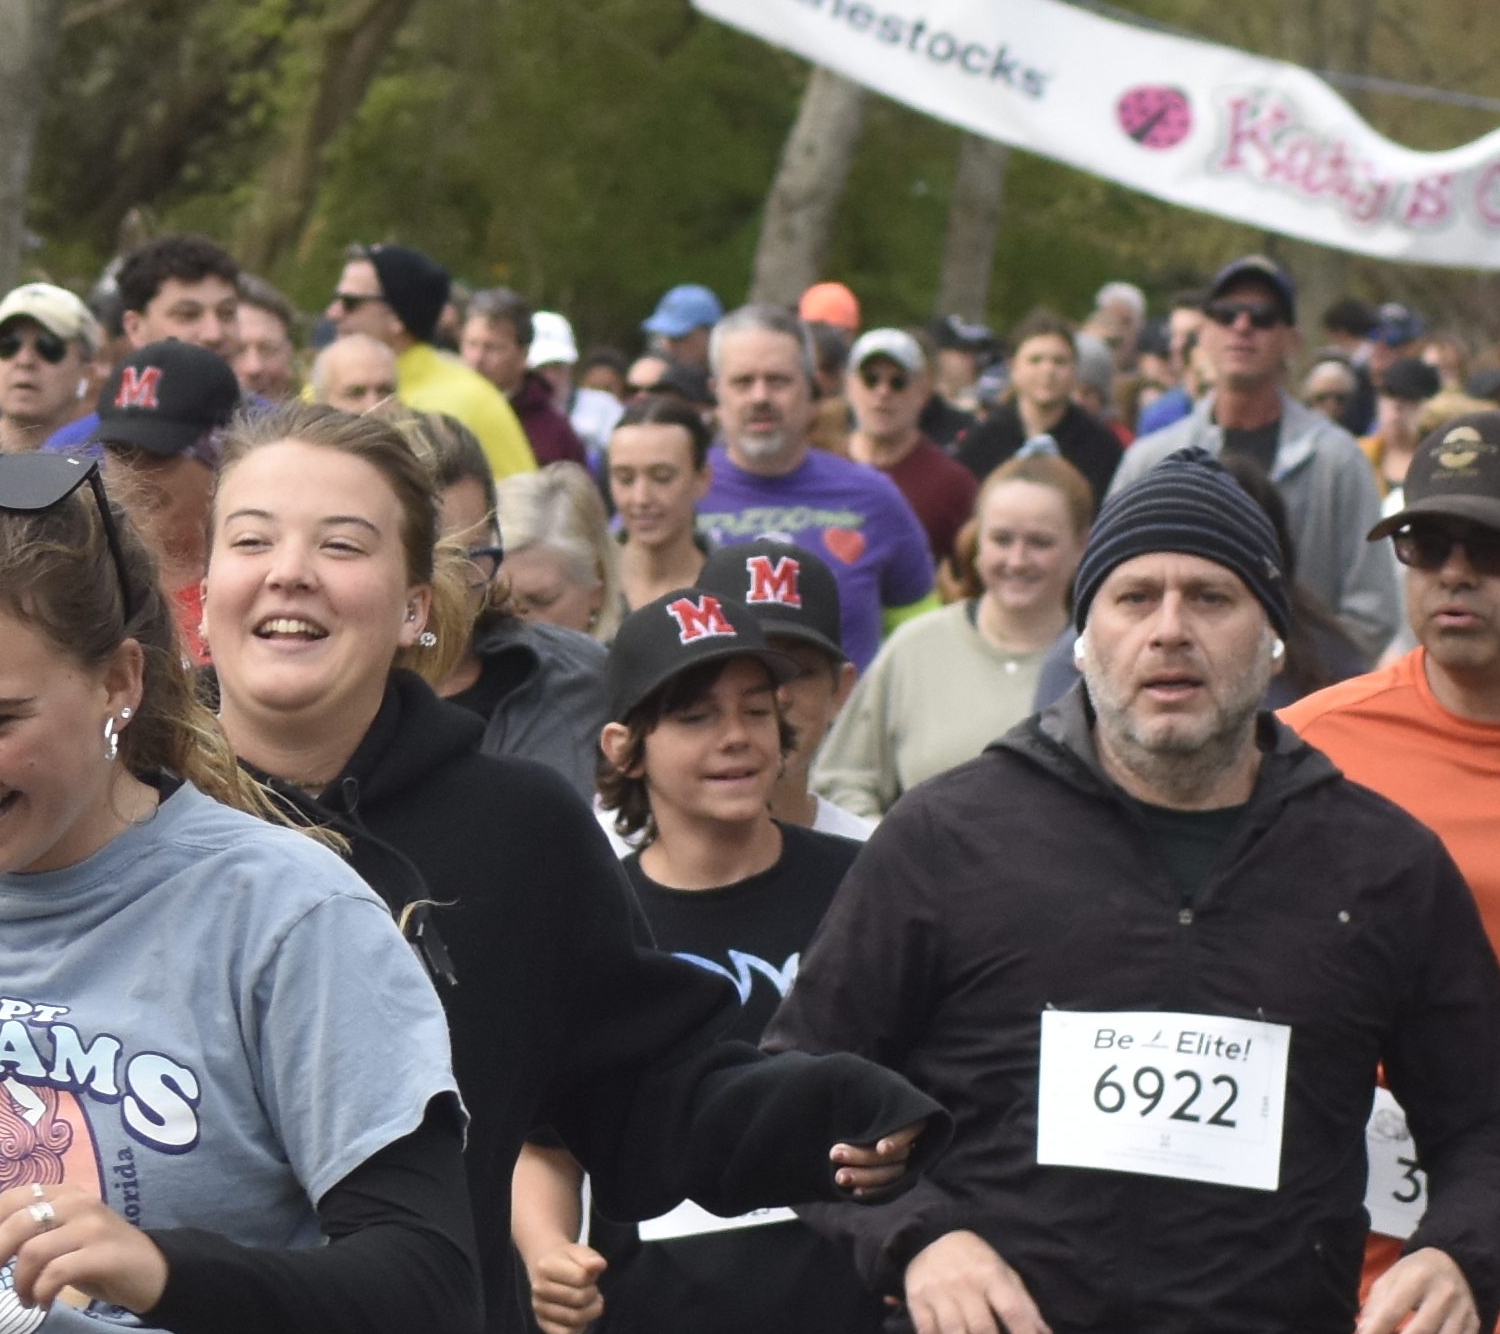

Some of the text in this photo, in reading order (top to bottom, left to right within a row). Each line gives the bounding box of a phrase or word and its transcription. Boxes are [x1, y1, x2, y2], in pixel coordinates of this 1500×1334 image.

[114, 366, 163, 408] M
[746, 555, 802, 609] M
[666, 595, 737, 645] M
[1093, 1028, 1253, 1062] Be Elite!
[1093, 1064, 1239, 1128] 6922
[113, 1145, 140, 1227] orida
